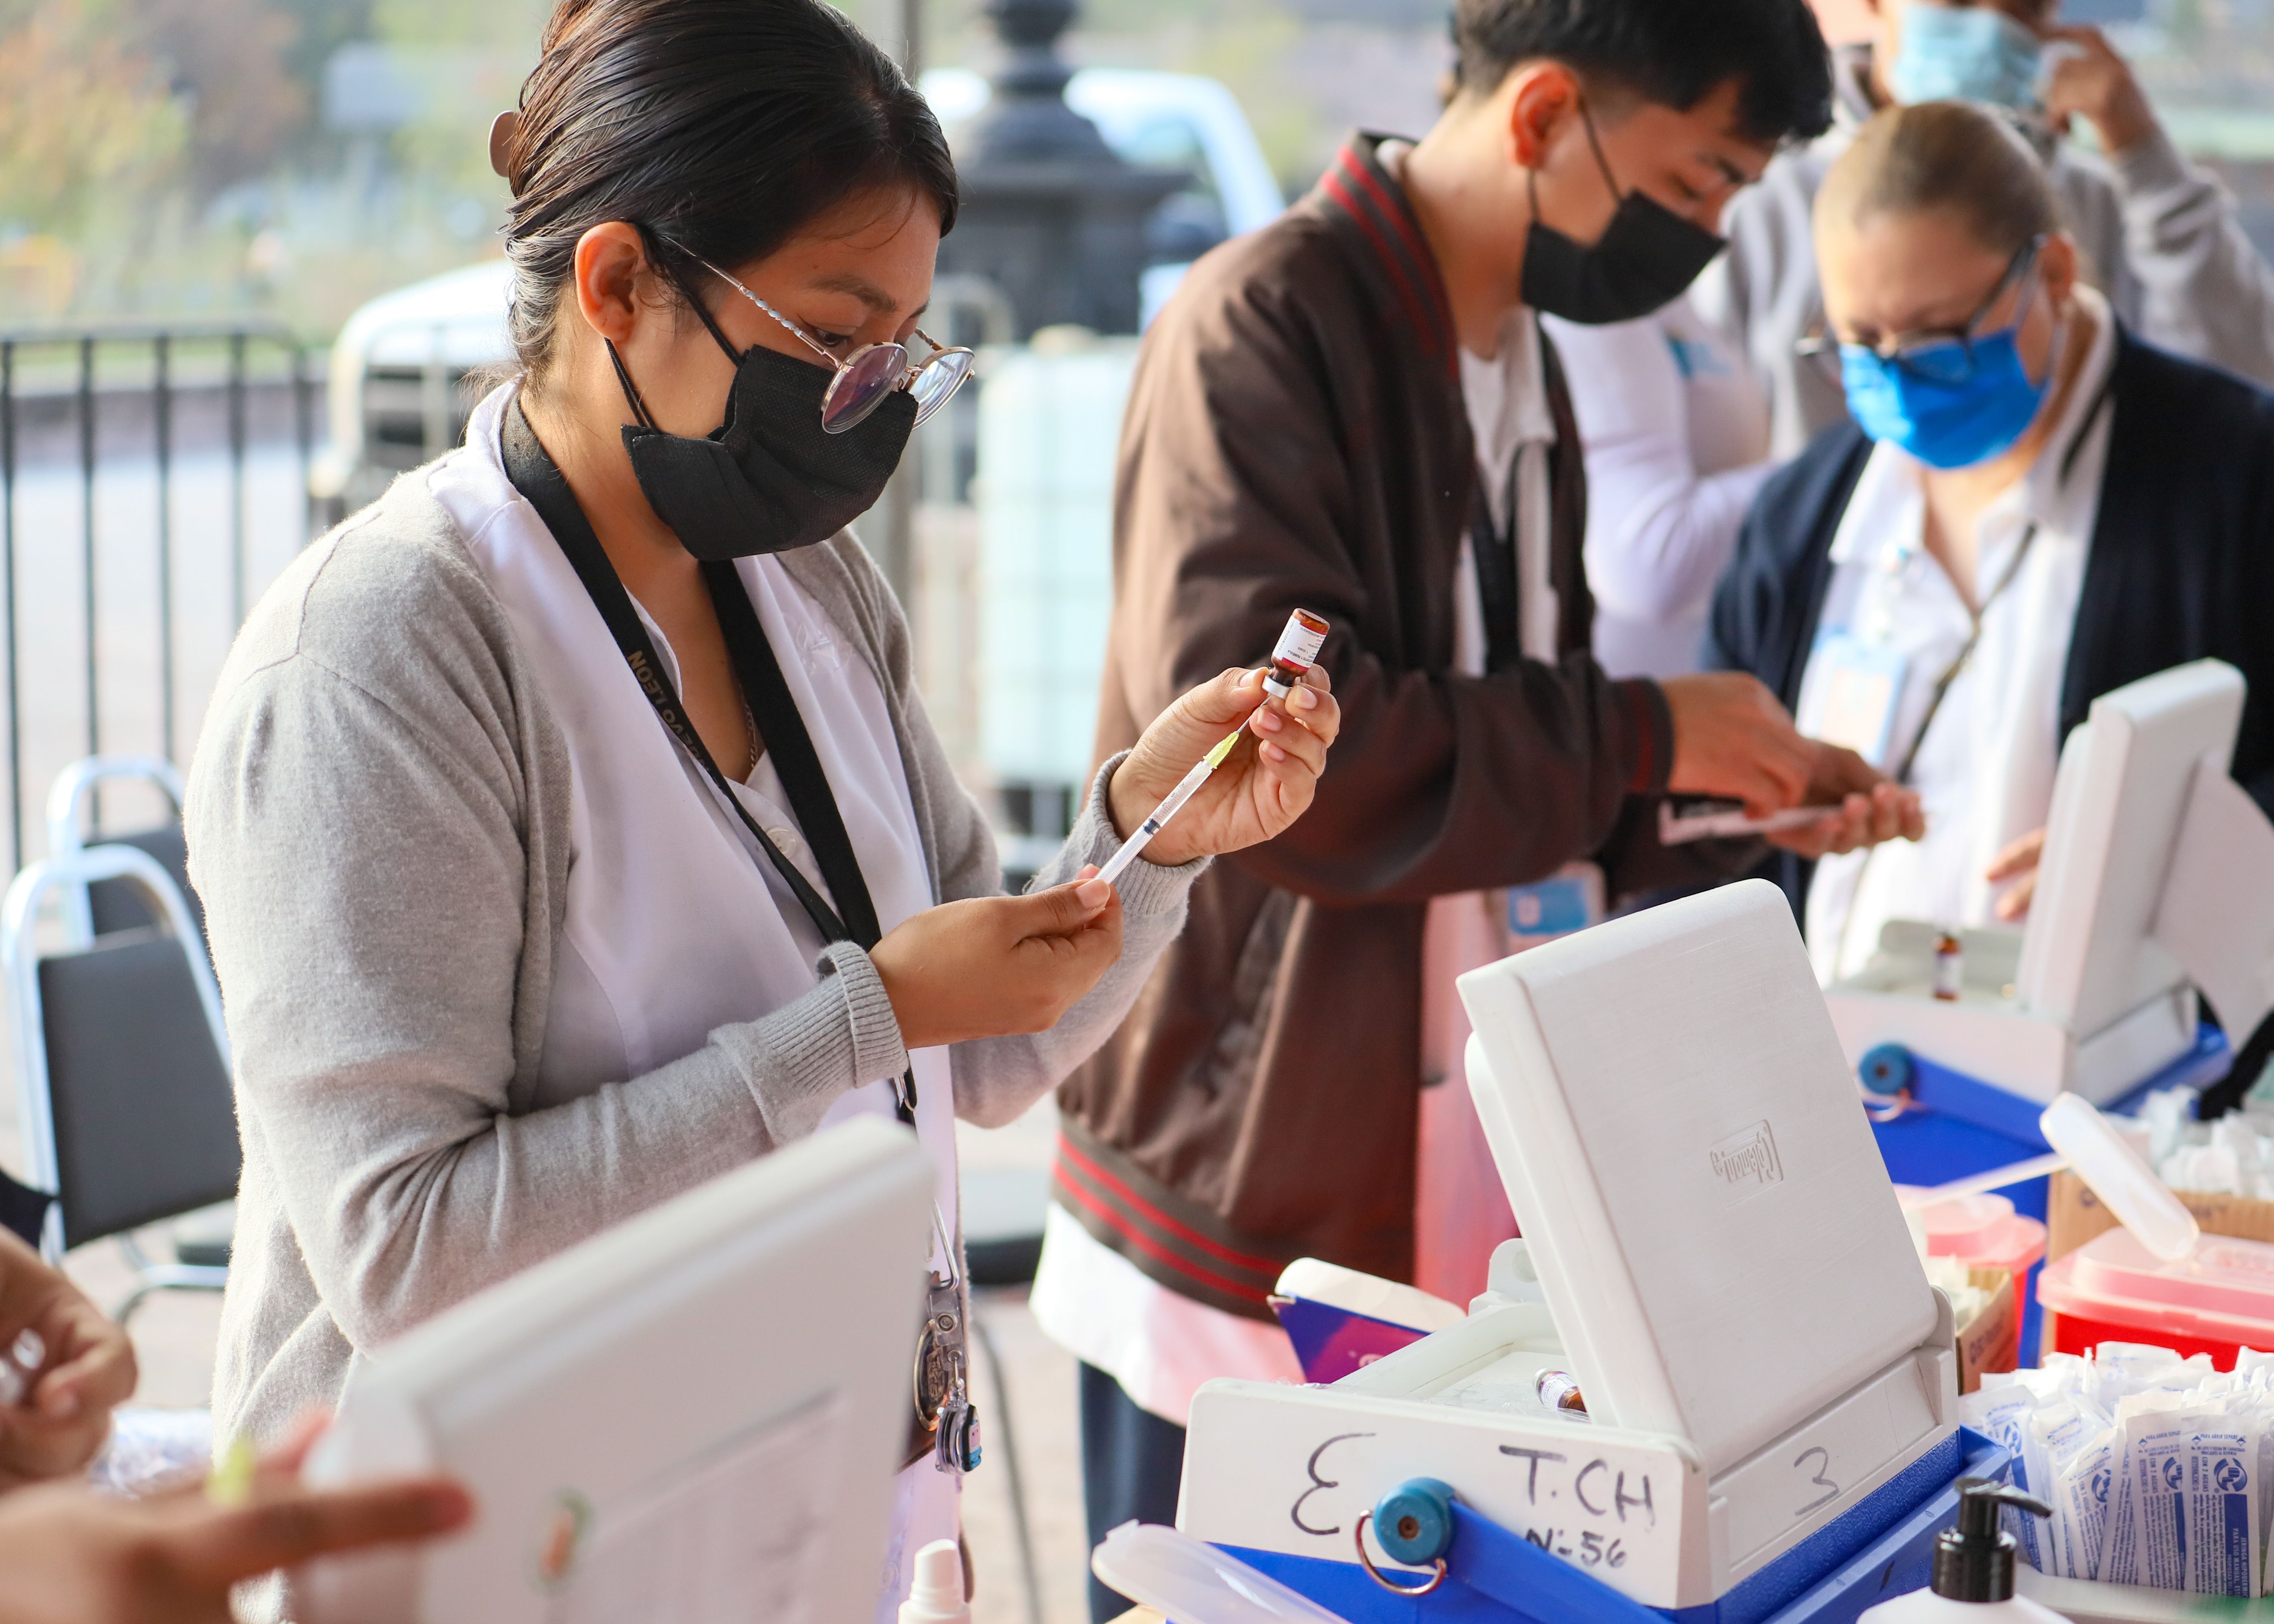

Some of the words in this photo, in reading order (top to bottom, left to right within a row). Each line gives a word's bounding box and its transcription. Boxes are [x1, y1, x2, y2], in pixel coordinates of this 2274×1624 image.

[1287, 650, 1301, 658] RUBÉOLA
[1722, 1131, 1774, 1183] Coleman
[1794, 1446, 1840, 1515] 3
